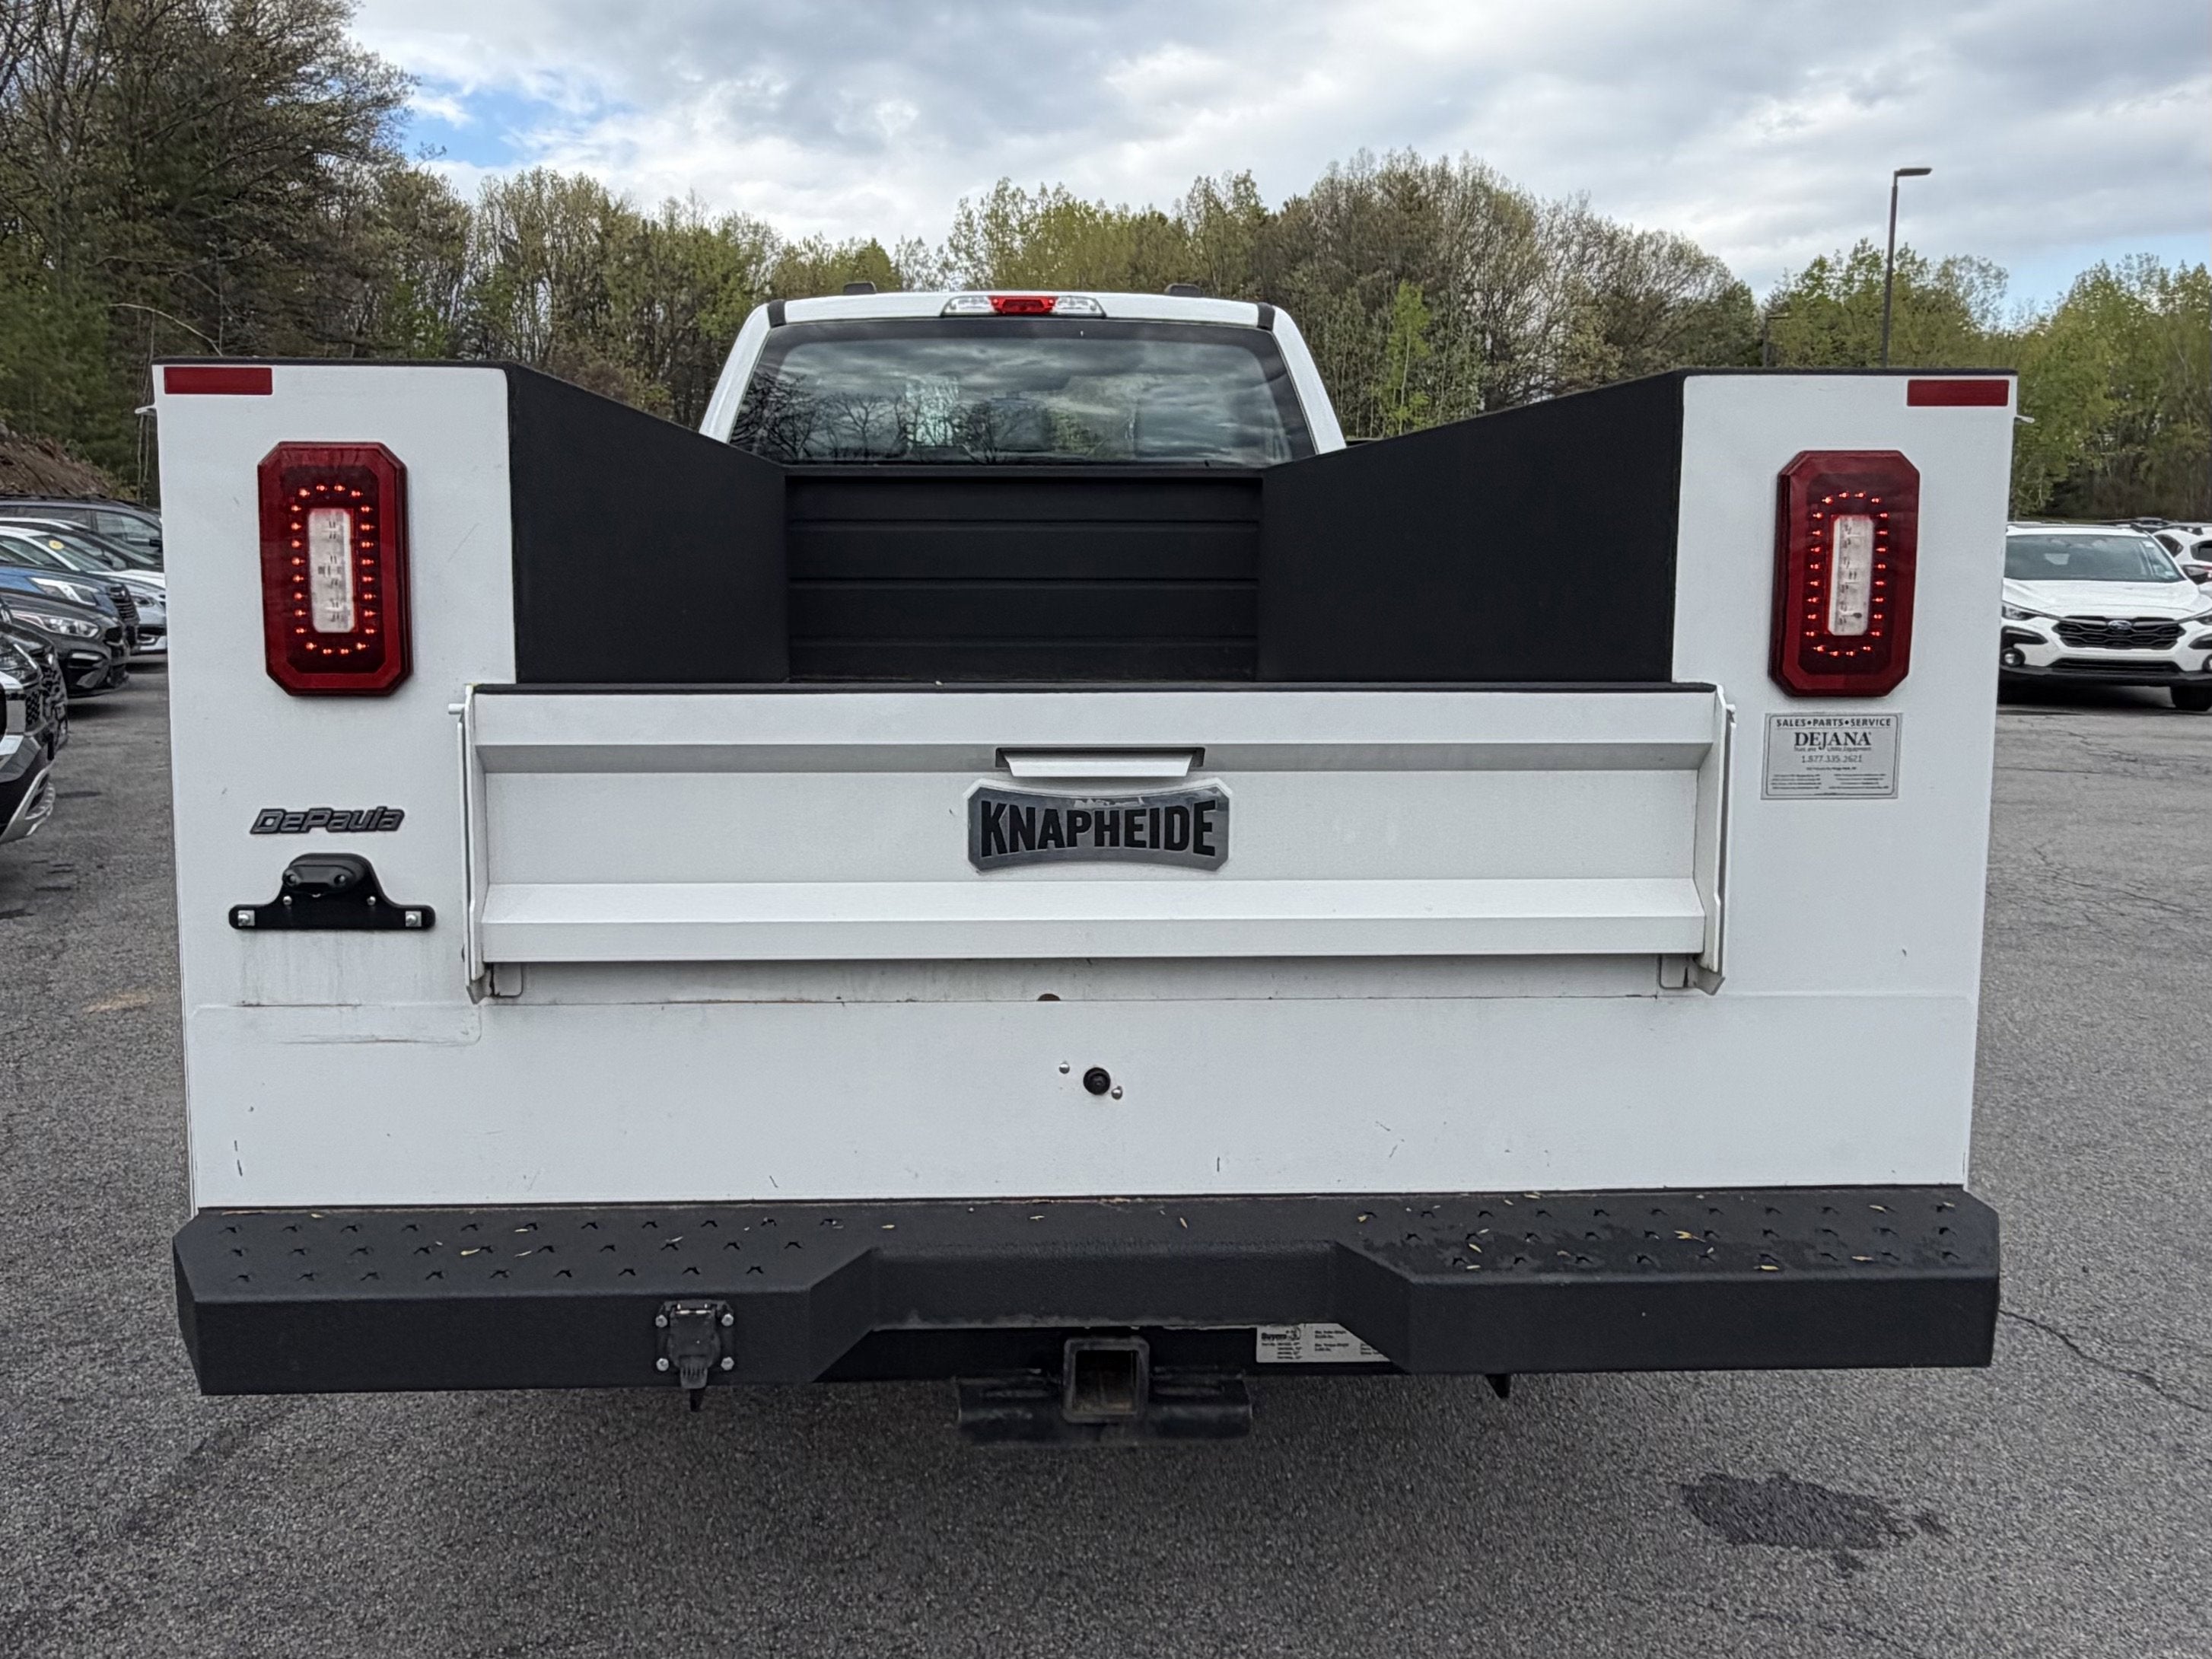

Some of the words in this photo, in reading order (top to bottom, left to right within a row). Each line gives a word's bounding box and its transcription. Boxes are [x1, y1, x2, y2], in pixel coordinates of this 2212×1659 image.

[1794, 731, 1871, 750] DEJANA
[250, 807, 405, 835] DePaula
[981, 799, 1216, 858] KNAPHEIDE
